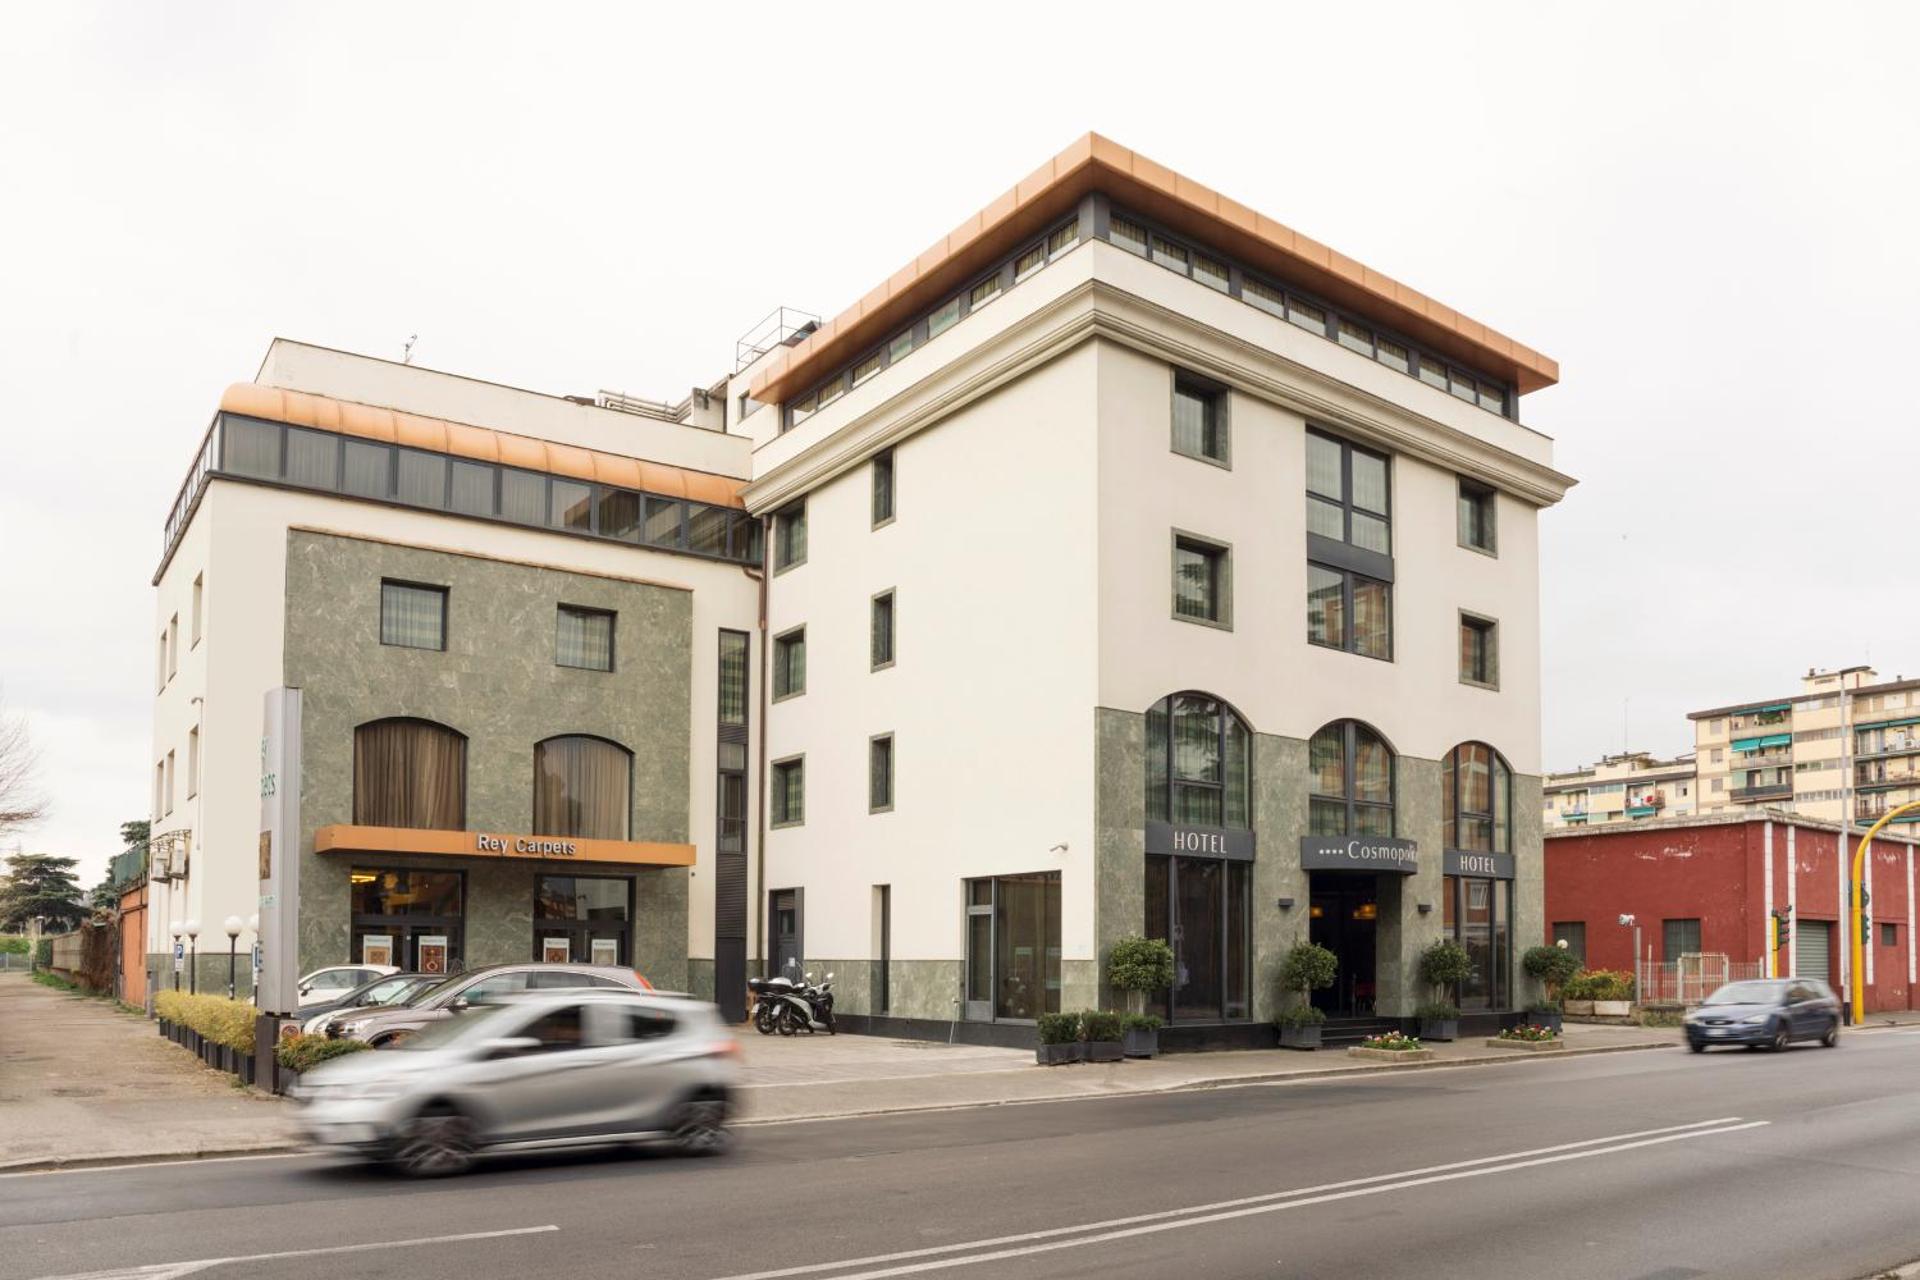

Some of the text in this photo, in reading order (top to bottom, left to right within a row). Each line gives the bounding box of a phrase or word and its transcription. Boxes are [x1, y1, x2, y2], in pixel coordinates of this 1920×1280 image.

[478, 833, 576, 855] Rey Carpets
[1174, 831, 1227, 854] HOTEL
[1460, 855, 1496, 874] HOTEL
